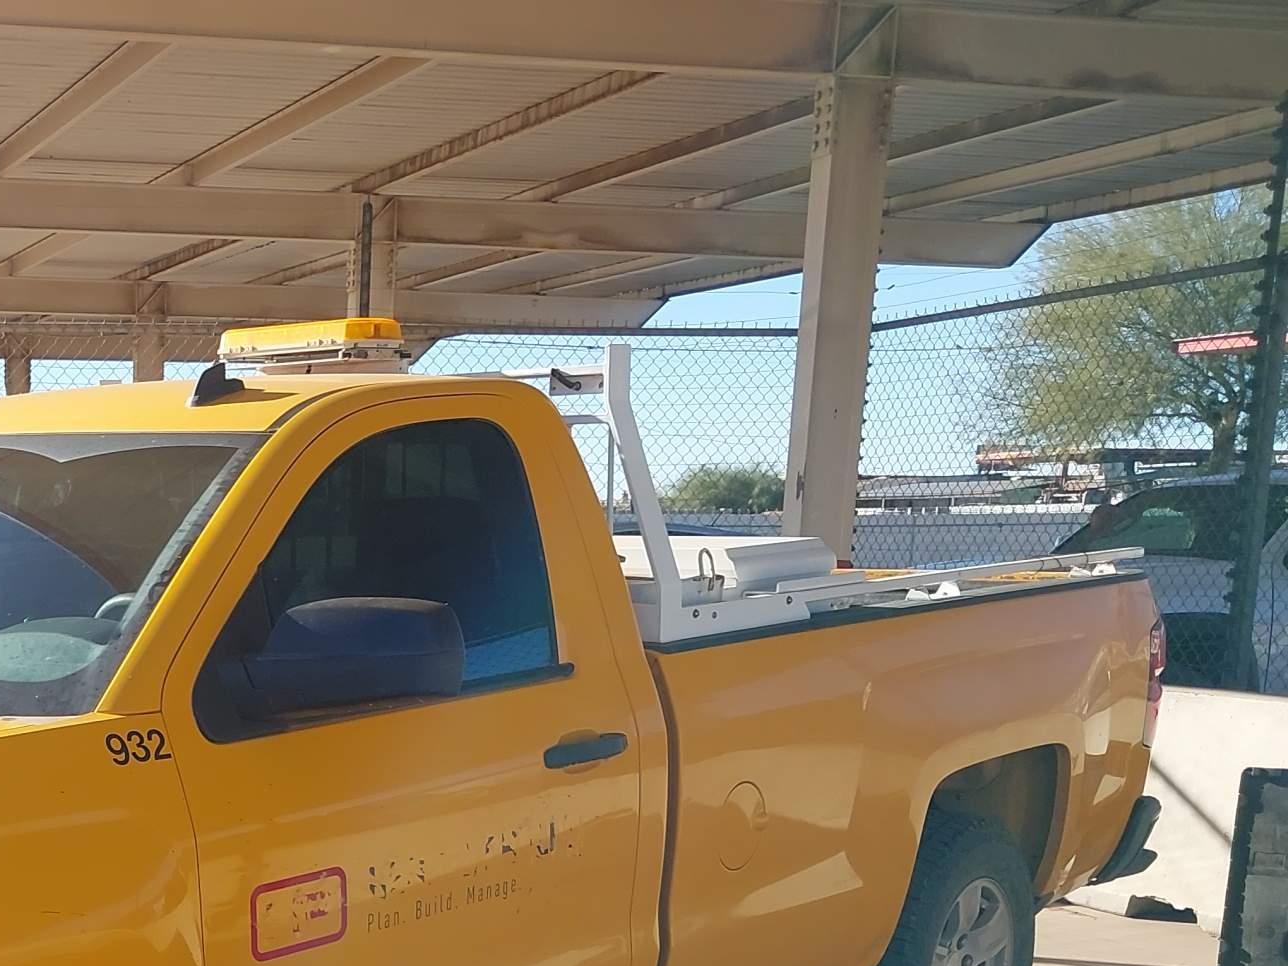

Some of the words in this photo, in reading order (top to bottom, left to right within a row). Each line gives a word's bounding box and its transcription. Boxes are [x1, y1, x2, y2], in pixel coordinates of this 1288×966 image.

[105, 728, 172, 765] 932
[367, 911, 406, 933] Plan.
[415, 892, 458, 920] Build.
[466, 879, 522, 905] Manage.
